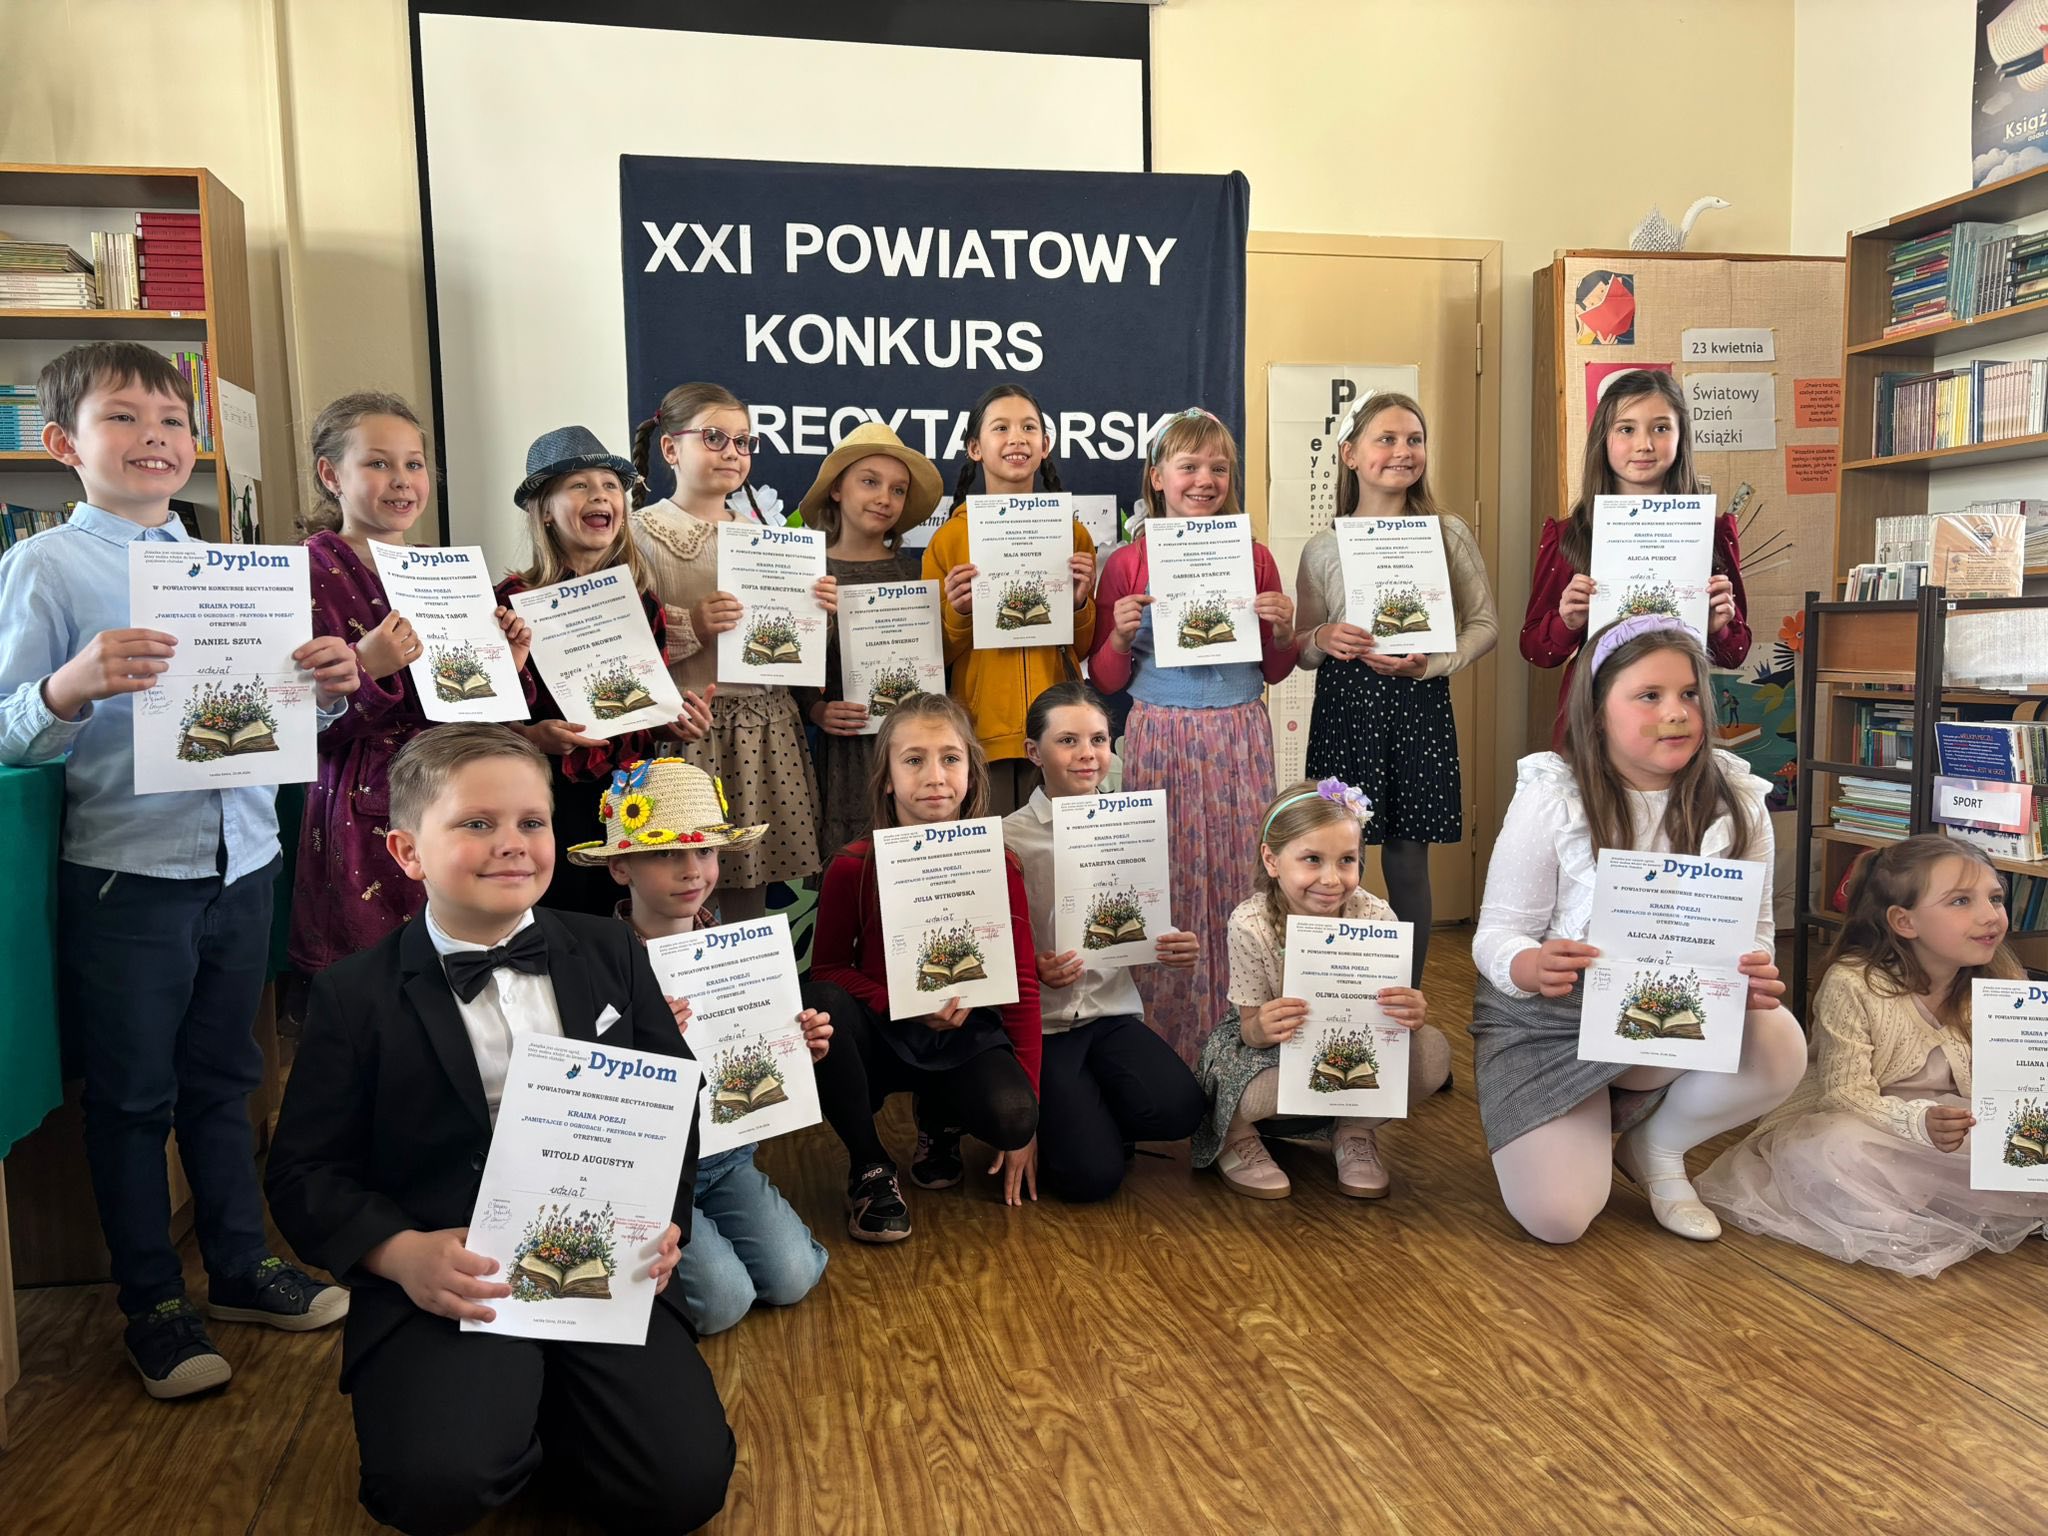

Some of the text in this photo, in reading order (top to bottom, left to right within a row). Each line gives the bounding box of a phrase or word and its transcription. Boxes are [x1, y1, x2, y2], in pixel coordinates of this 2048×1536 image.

[642, 221, 1177, 286] XXI POWIATOWY
[745, 314, 1044, 371] KONKURS
[1692, 342, 1763, 354] 23 kwietnia
[1332, 379, 1356, 414] P
[1693, 382, 1759, 402] Światowy
[1693, 406, 1732, 420] Dzień
[1325, 417, 1335, 435] r
[755, 406, 1172, 461] RECYTARSK
[1695, 430, 1743, 446] Książki
[1311, 438, 1322, 451] e
[1311, 454, 1336, 467] y t
[1311, 470, 1314, 478] t
[1311, 483, 1316, 492] p
[1009, 498, 1059, 510] Dyplom
[1642, 499, 1701, 512] Dyplom
[1187, 520, 1237, 532] Dyplom
[1377, 520, 1427, 531] Dyplom
[762, 530, 814, 544] Dyplom
[206, 550, 289, 570] Dyplom
[408, 552, 469, 566] Dyplom
[558, 575, 618, 598] Dyplom
[878, 586, 927, 599] Dyplom
[194, 638, 229, 646] DANIEL
[564, 635, 622, 655] DOROTA SKOWRON
[1099, 797, 1152, 812] Dyplom
[1953, 796, 1983, 808] SPORT
[925, 825, 987, 843] Dyplom
[1080, 860, 1115, 868] KATARZYNA
[1663, 860, 1743, 880] Dyplom
[913, 890, 975, 903] JULIA WITKOWSKA
[1660, 889, 1692, 897] KONKURSIE
[1694, 892, 1743, 901] RECYTATORSKIM
[705, 926, 773, 949] Dyplom
[1339, 924, 1398, 940] Dyplom
[1627, 931, 1657, 939] ALICJA
[678, 966, 710, 977] POWIATOWYM
[706, 973, 750, 986] KRAINA POEZJI
[697, 999, 770, 1022] WOJCIECH WOŹNIAK
[587, 1051, 678, 1083] Dyplom
[536, 1084, 581, 1097] POWIATOWYM
[582, 1091, 619, 1102] KONKURSIE
[620, 1097, 674, 1110] RECYTATORSKIM
[568, 1110, 626, 1124] KRAINA POEZJI
[569, 1123, 601, 1131] OGRODACH
[573, 1134, 611, 1143] OTRZYMUJE
[542, 1149, 634, 1168] WITOLD AUGUSTYN
[550, 1186, 586, 1197] udział
